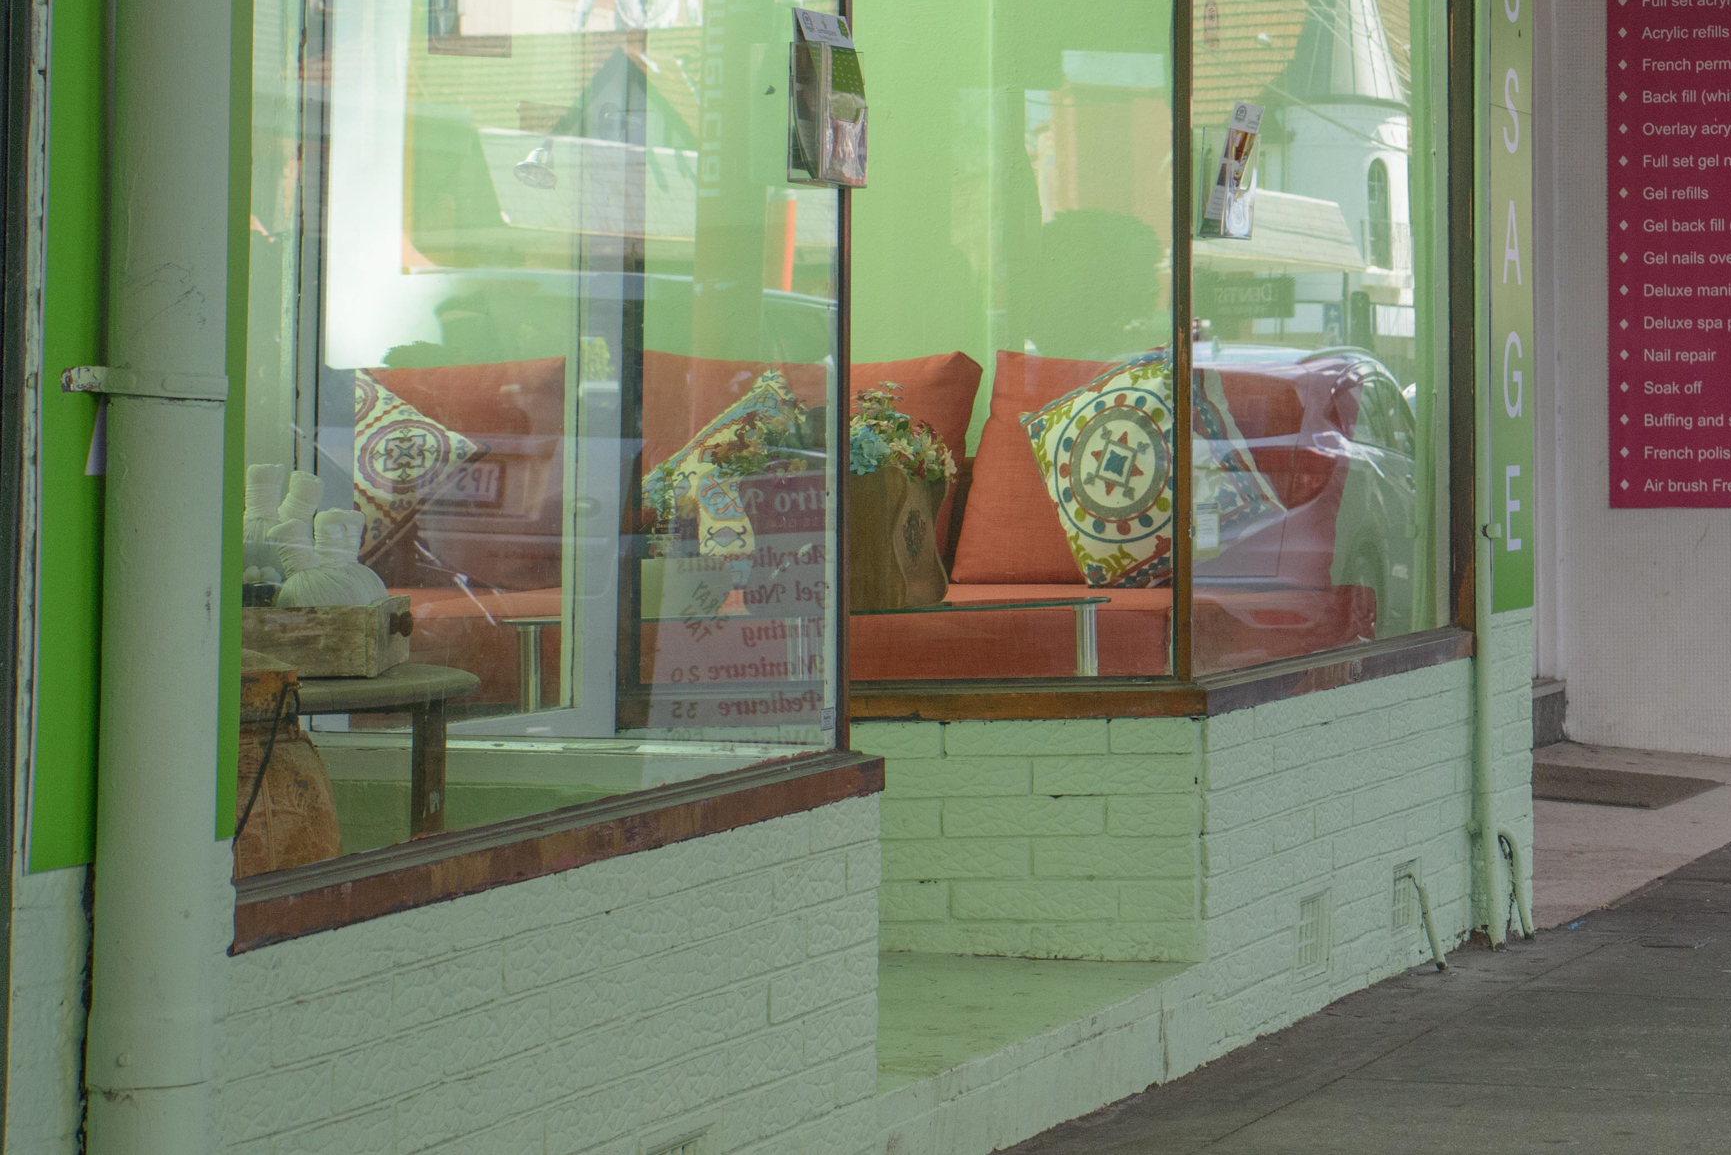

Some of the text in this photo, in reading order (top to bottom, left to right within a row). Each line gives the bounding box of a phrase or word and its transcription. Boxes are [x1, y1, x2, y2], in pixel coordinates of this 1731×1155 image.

[1642, 25, 1729, 41] Acrylic refills
[1642, 59, 1691, 71] French
[1643, 91, 1677, 103] Back
[1682, 90, 1697, 102] fill
[1643, 123, 1697, 137] Overlay
[1643, 155, 1668, 167] Full
[1673, 156, 1694, 167] set
[1698, 155, 1719, 170] gel
[1643, 187, 1709, 199] Gel refills
[1643, 219, 1667, 232] Gel
[1672, 219, 1705, 232] back
[1710, 218, 1724, 231] fill
[1644, 252, 1667, 265] Gel
[1673, 252, 1704, 264] nails
[1644, 284, 1692, 297] Deluxe
[1644, 317, 1692, 329] Deluxe
[1697, 319, 1722, 332] spa
[1644, 349, 1716, 364] Nail repair
[1644, 381, 1703, 394] Soak off
[1644, 414, 1693, 430] Buffing
[1698, 414, 1724, 427] and
[1644, 447, 1693, 459] French
[1644, 479, 1663, 492] Air
[1668, 479, 1707, 492] brush
